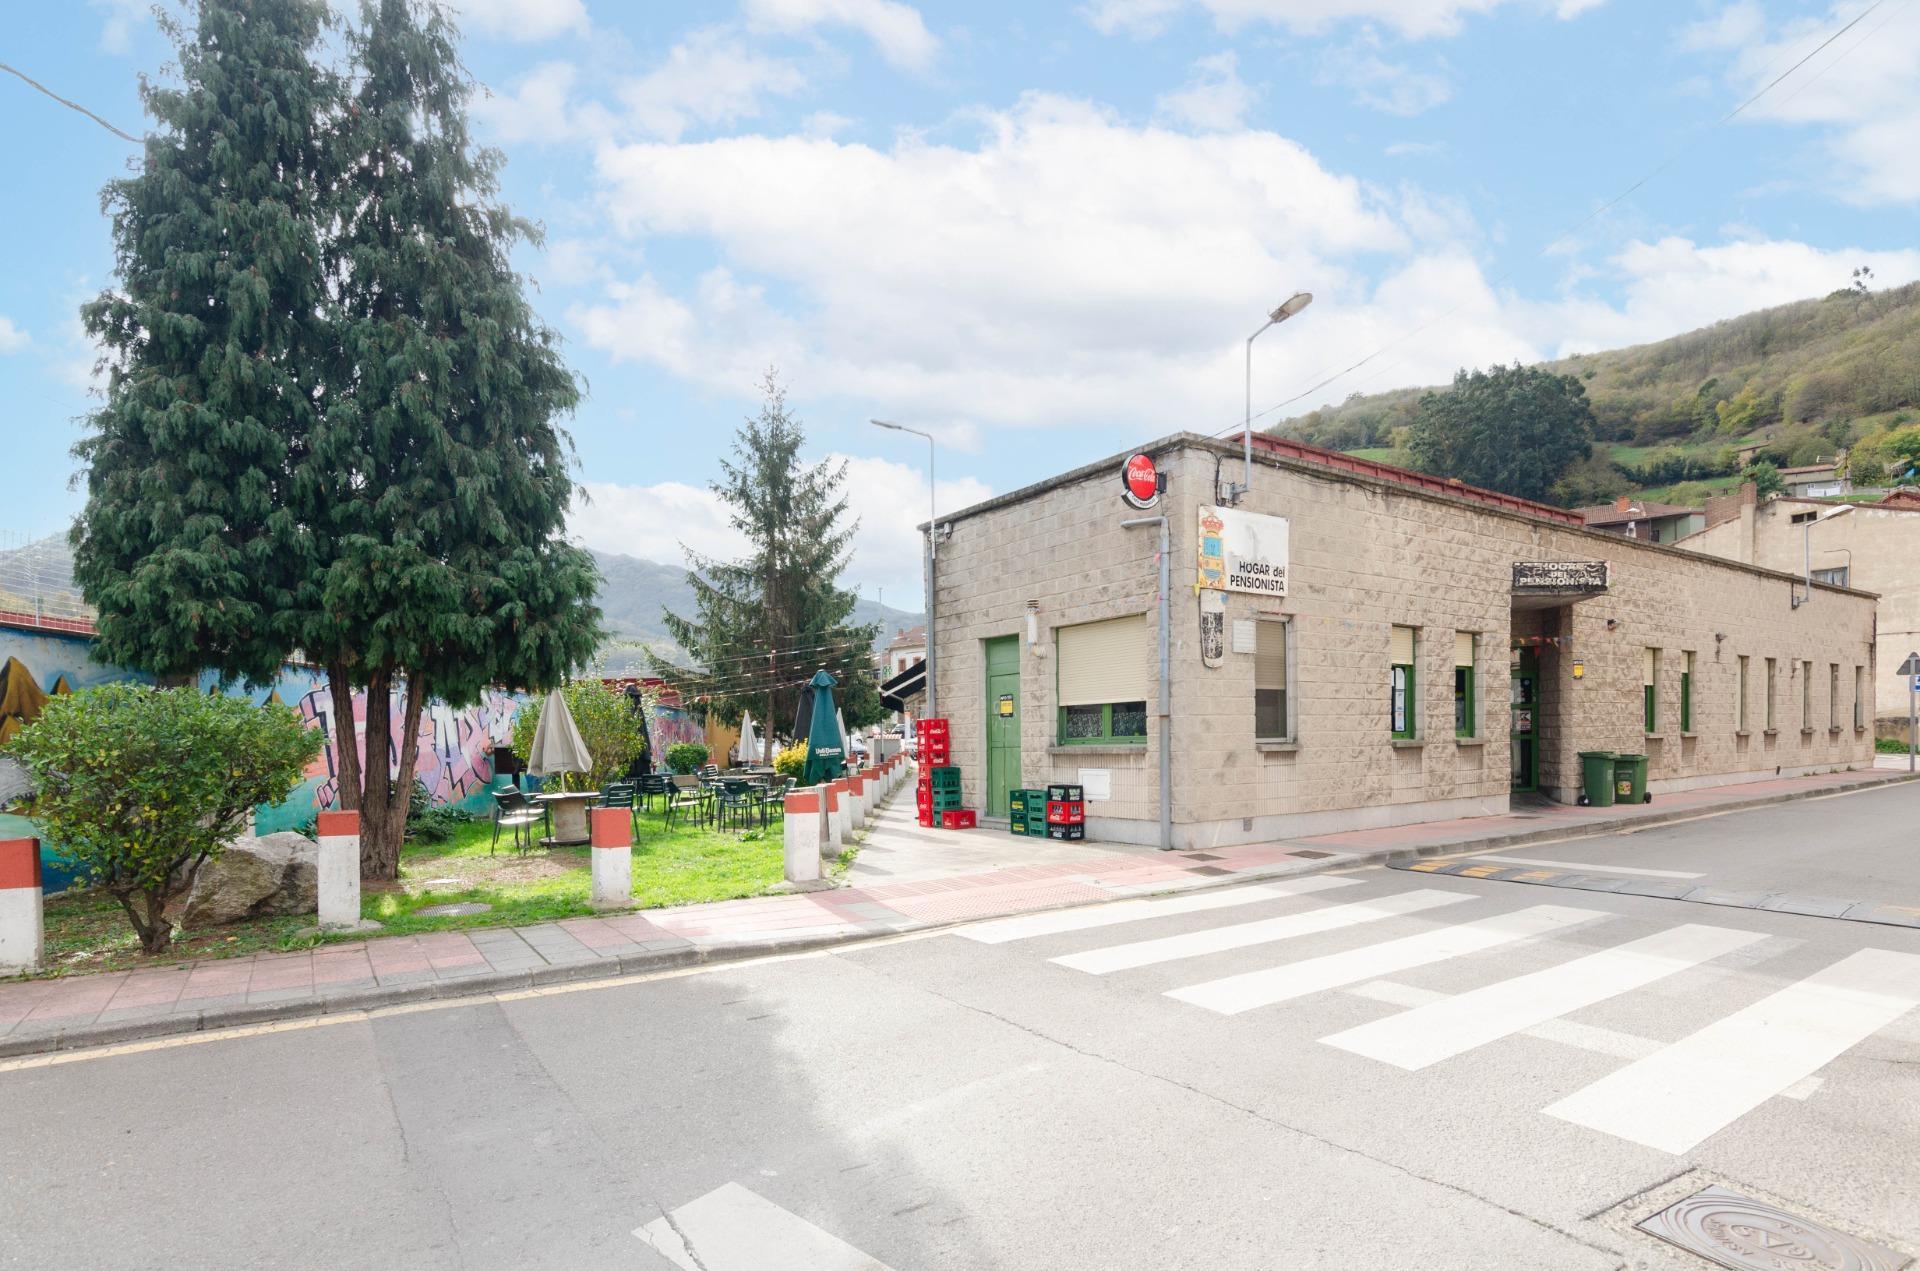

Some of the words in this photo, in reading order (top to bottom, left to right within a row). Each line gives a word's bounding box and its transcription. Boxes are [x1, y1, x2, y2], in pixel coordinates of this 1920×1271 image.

[1239, 560, 1270, 576] HOGAR
[1273, 566, 1285, 578] del
[1230, 574, 1285, 592] PENSIONISTA
[1519, 577, 1602, 586] PENSIONISTA
